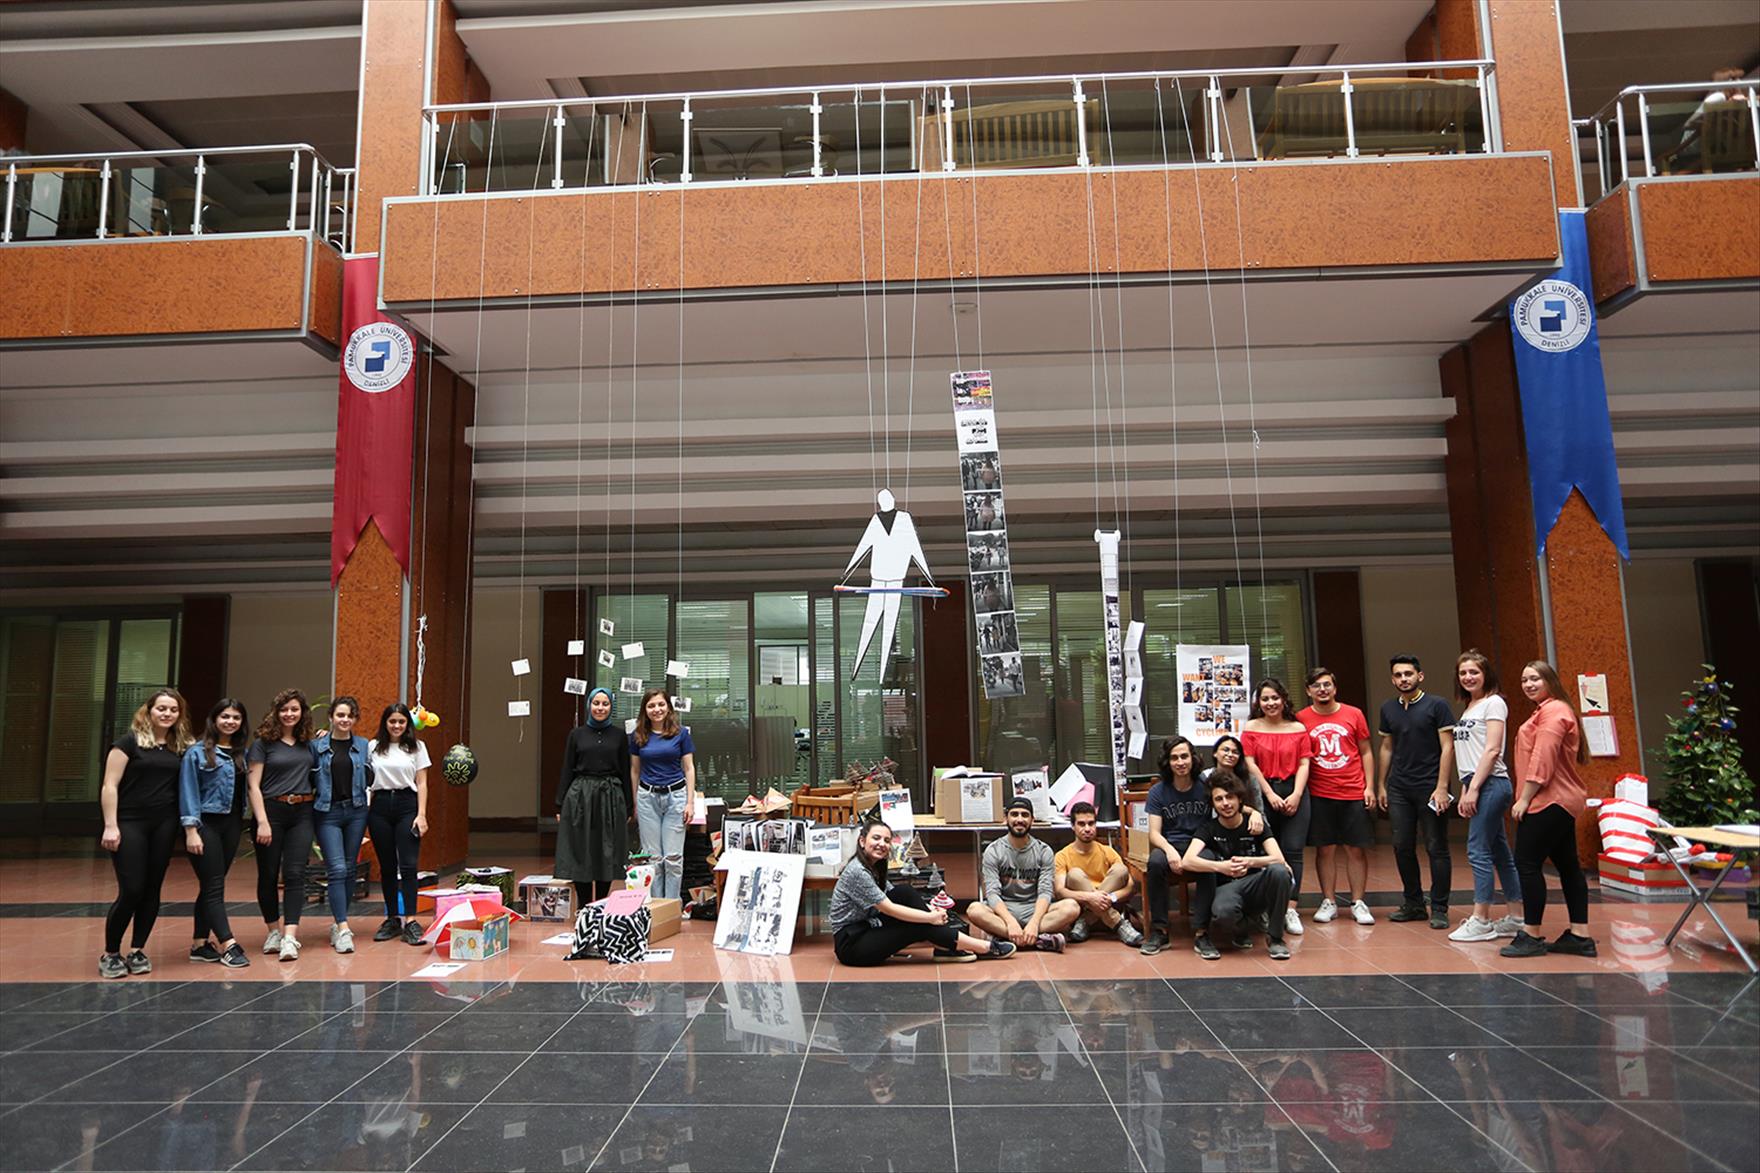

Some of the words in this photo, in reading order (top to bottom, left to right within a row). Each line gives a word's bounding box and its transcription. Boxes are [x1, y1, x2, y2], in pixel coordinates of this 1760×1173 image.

[1519, 285, 1547, 327] PAMUKKALE
[348, 328, 376, 368] PAMUKKALE
[1213, 655, 1226, 664] WE
[1182, 672, 1206, 682] WANT
[1317, 733, 1343, 757] M
